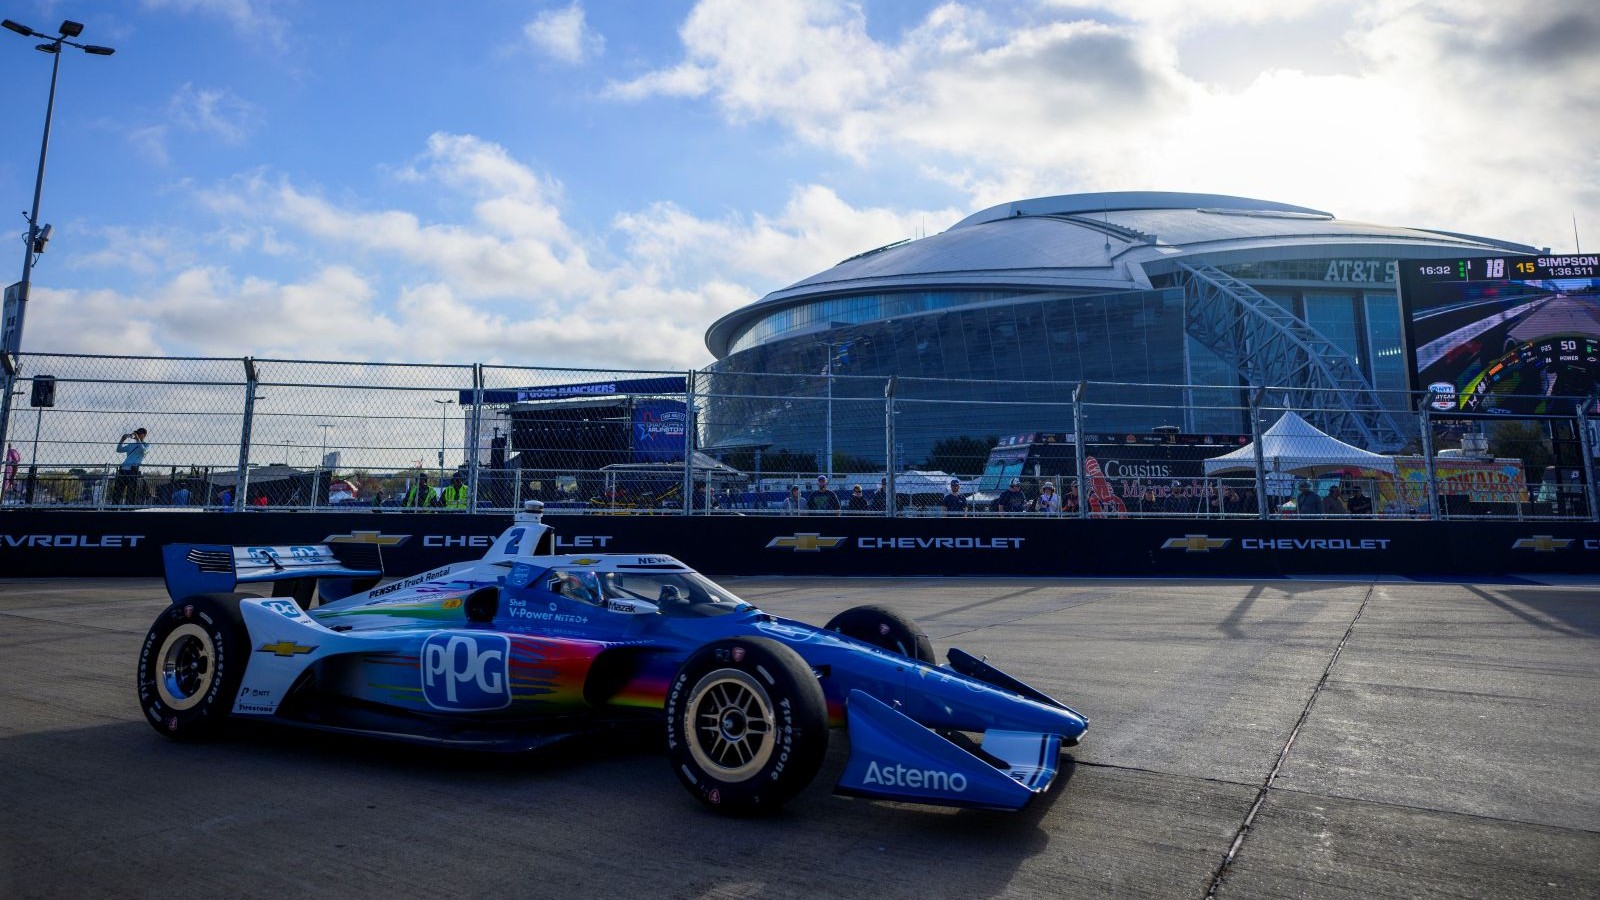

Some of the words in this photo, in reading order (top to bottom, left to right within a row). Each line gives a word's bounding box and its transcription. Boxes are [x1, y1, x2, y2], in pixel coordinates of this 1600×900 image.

[1324, 260, 1380, 282] AT&T
[1420, 266, 1451, 275] 16:32
[1486, 259, 1505, 278] 18
[1516, 263, 1535, 273] 15
[1538, 256, 1599, 267] SIMPSON
[1549, 267, 1593, 276] 1:36.511
[1561, 340, 1577, 350] 50
[558, 383, 616, 396] RANCHERS
[1104, 459, 1169, 480] Cousins
[0, 535, 145, 547] VROLET
[504, 528, 525, 554] 2
[858, 537, 1024, 548] CHEVROLET
[1242, 538, 1391, 549] CHEVROLET
[1584, 539, 1600, 549] C
[368, 582, 402, 599] PENSKE
[404, 575, 424, 589] Truck
[425, 566, 451, 582] Rental
[509, 598, 527, 607] Shell
[608, 601, 636, 613] Mazak
[509, 607, 553, 621] V-Power
[141, 632, 157, 701] Firestone
[207, 631, 224, 704] Firestone
[238, 704, 273, 712] Firestone
[667, 673, 688, 750] Firestone
[770, 697, 793, 781] Firestone
[862, 760, 967, 792] Astemo
